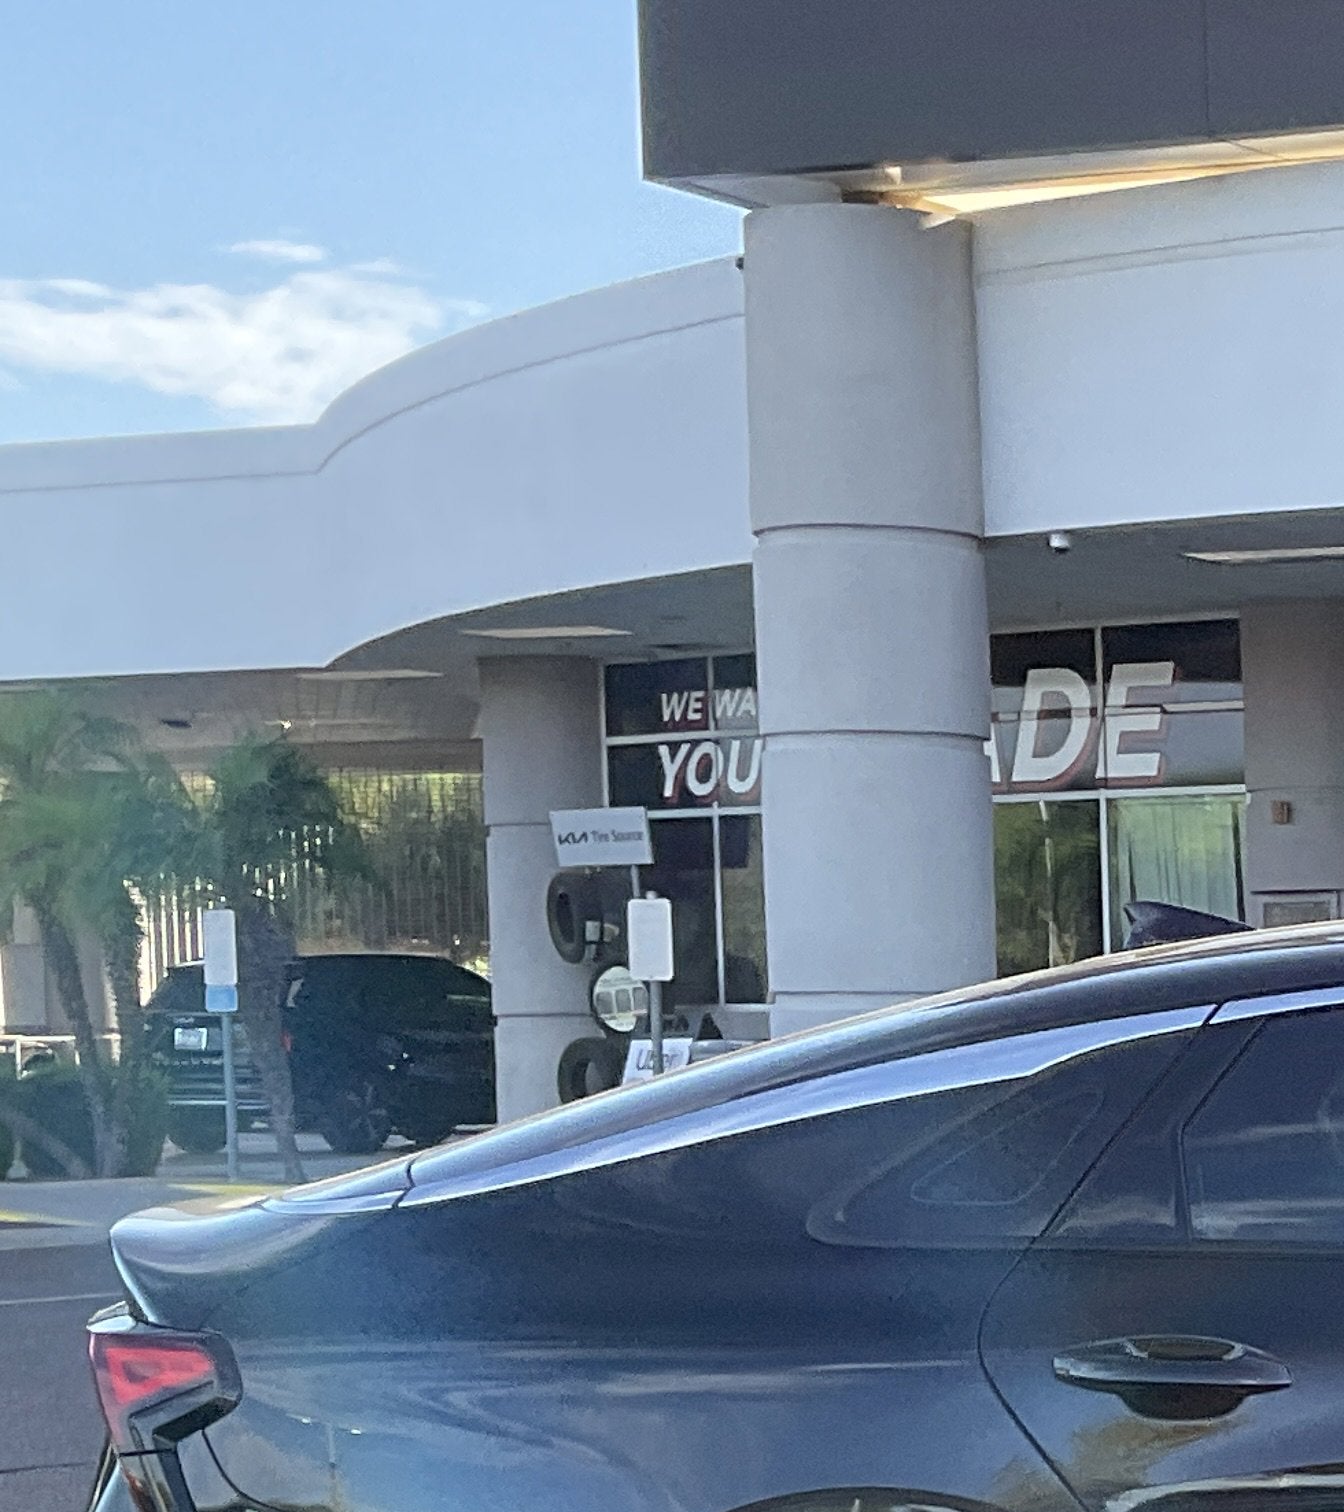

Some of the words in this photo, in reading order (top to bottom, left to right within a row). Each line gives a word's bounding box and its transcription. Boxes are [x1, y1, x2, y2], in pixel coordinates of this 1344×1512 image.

[661, 690, 705, 722] WE
[714, 686, 757, 719] WA
[657, 739, 763, 798] YOU
[557, 831, 588, 846] KIA
